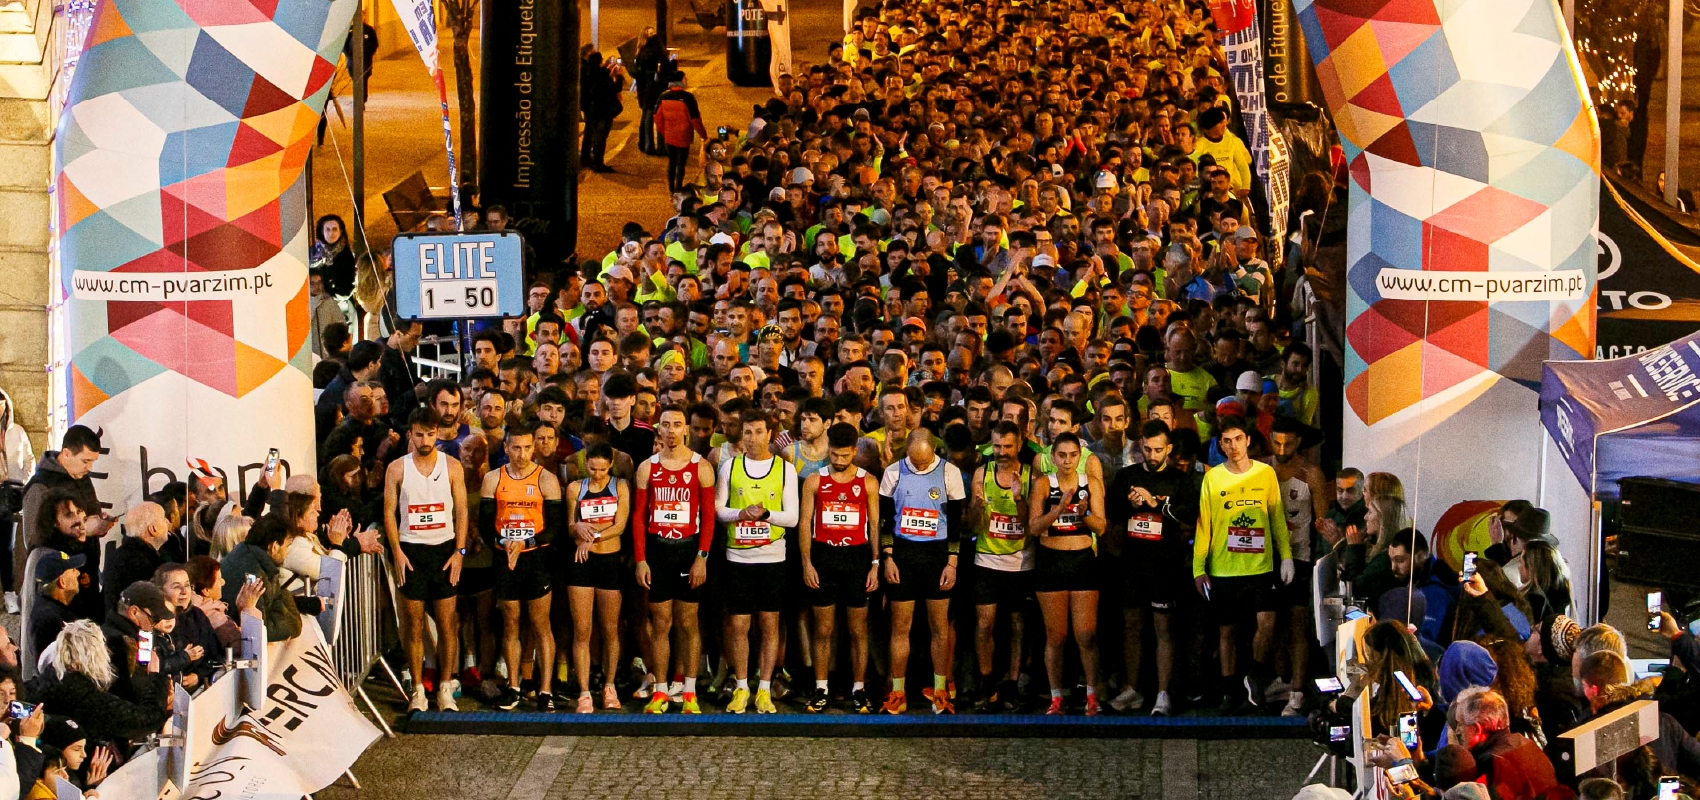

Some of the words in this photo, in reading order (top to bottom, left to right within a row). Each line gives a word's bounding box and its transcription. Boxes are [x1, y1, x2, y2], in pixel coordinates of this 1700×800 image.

[1268, 0, 1289, 57] Etique
[514, 71, 532, 94] de
[1268, 64, 1287, 86] de
[513, 100, 535, 188] Impressão
[419, 242, 497, 280] ELITE
[74, 271, 273, 299] www.cm-pvarzim.pt
[1381, 274, 1583, 299] www.cm-pvarzim.pt
[425, 288, 435, 310] 1
[465, 287, 494, 308] 50
[1597, 290, 1673, 310] TO
[592, 505, 605, 513] 31
[1235, 499, 1263, 507] CCK
[419, 514, 434, 523] 25
[664, 513, 678, 521] 48
[833, 514, 847, 522] 50
[1136, 521, 1150, 529] 49
[1238, 536, 1253, 545] 42
